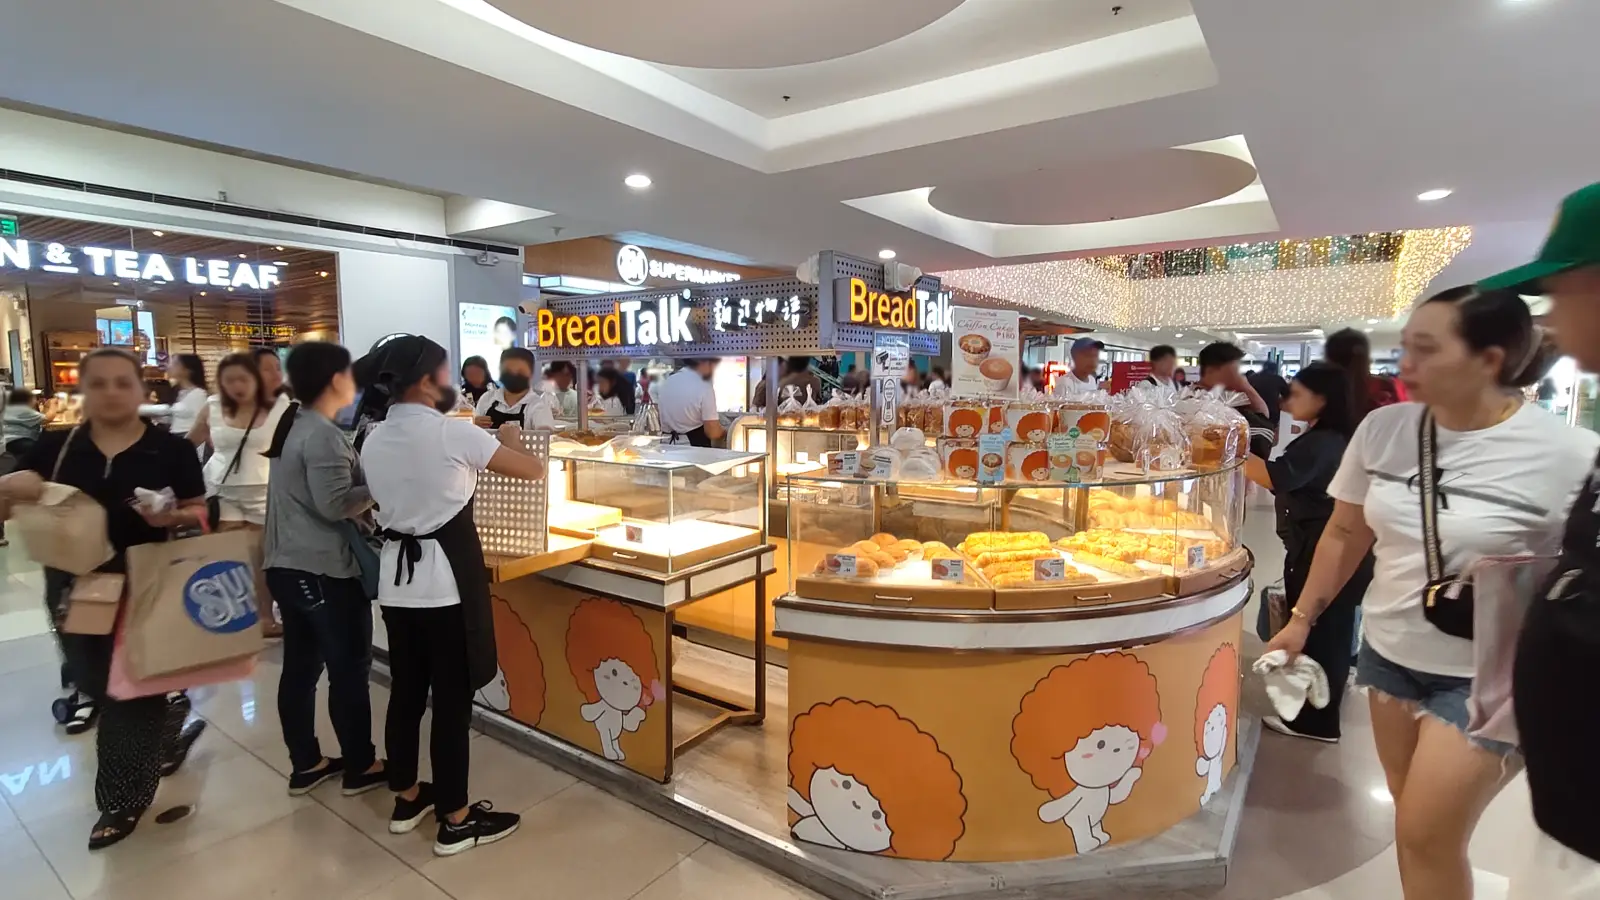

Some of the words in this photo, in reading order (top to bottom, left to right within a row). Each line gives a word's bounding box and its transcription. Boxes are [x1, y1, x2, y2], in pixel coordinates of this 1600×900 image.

[46, 242, 73, 265] &
[83, 246, 174, 281] TEA
[185, 257, 279, 290] LEAF
[537, 294, 694, 348] BreadTalk
[850, 277, 954, 333] BreadTalk
